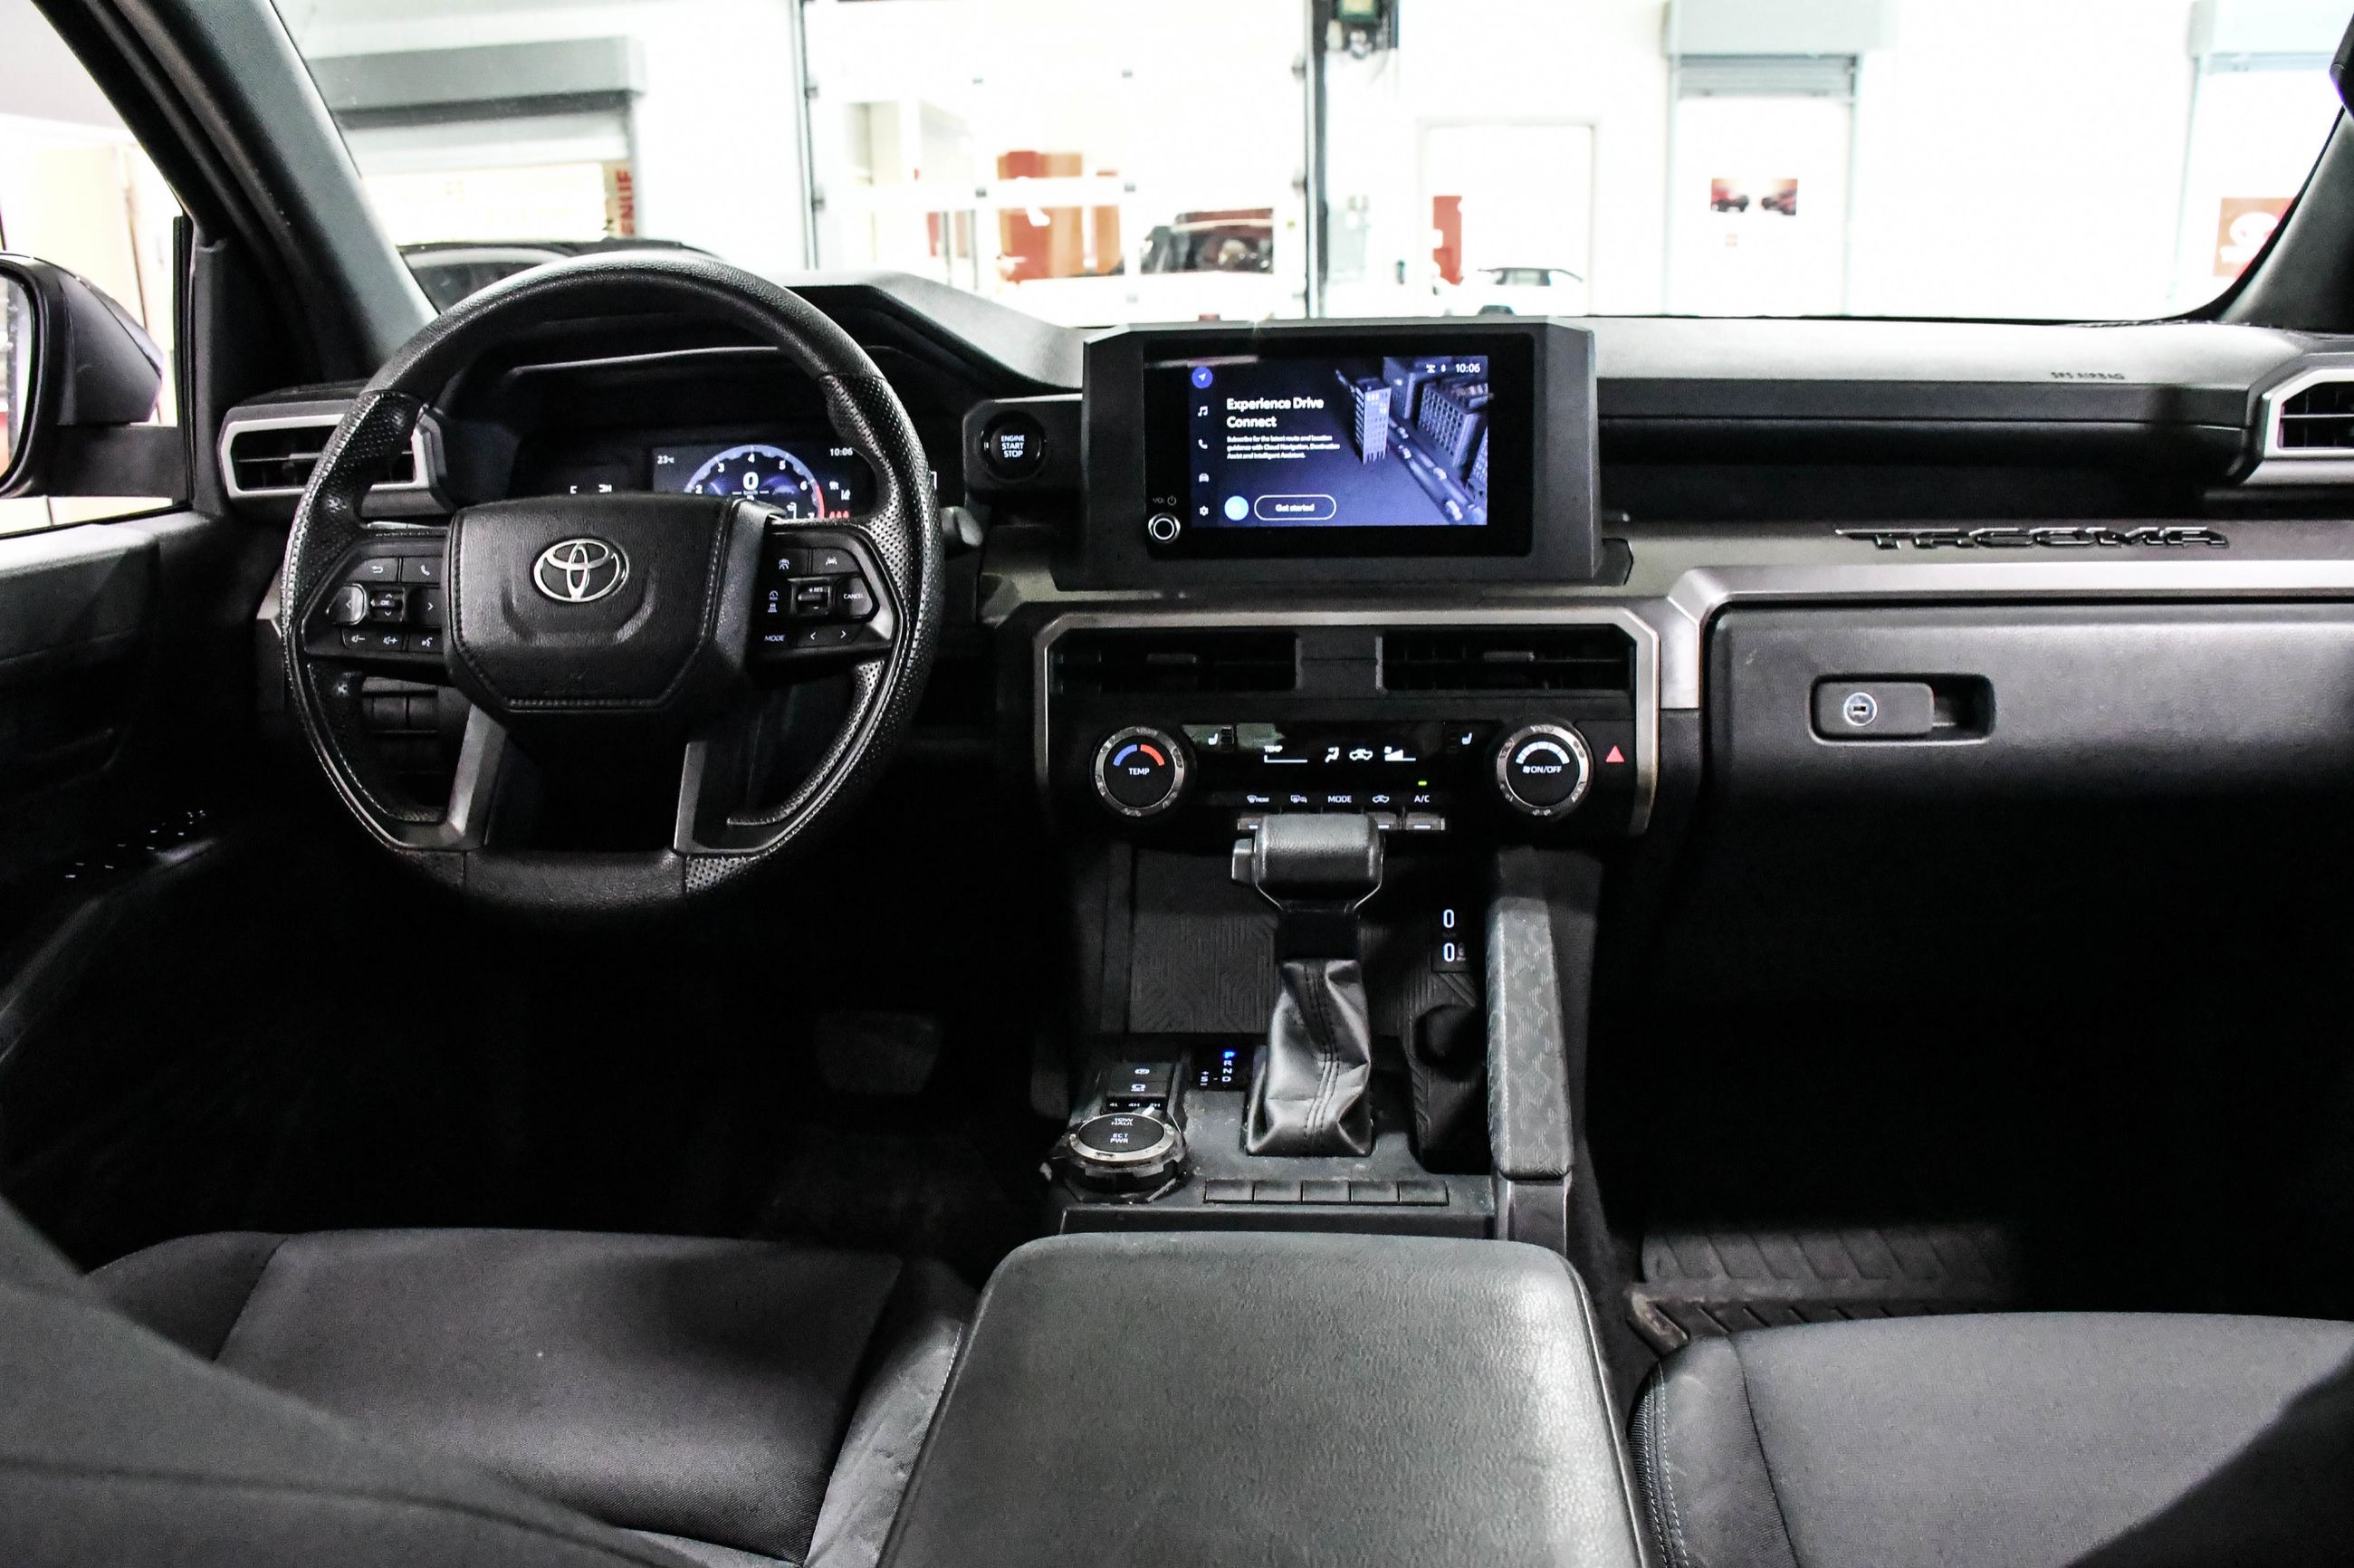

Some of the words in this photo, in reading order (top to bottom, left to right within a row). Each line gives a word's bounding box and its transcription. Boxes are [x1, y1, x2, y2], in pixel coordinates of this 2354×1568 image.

[1456, 364, 1480, 374] 10:06
[1227, 397, 1292, 412] Experience
[1293, 397, 1325, 409] Drive
[1227, 416, 1277, 428] Connect
[748, 454, 755, 463] 4
[779, 460, 786, 470] 5
[742, 472, 759, 491] 0
[800, 481, 808, 491] 6
[1276, 504, 1289, 512] Get
[1835, 527, 2230, 550] TACOMA
[1531, 766, 1562, 774] ON/OFF
[1327, 795, 1353, 803] MODE
[1414, 795, 1431, 803] A/C
[1224, 1051, 1235, 1059] P
